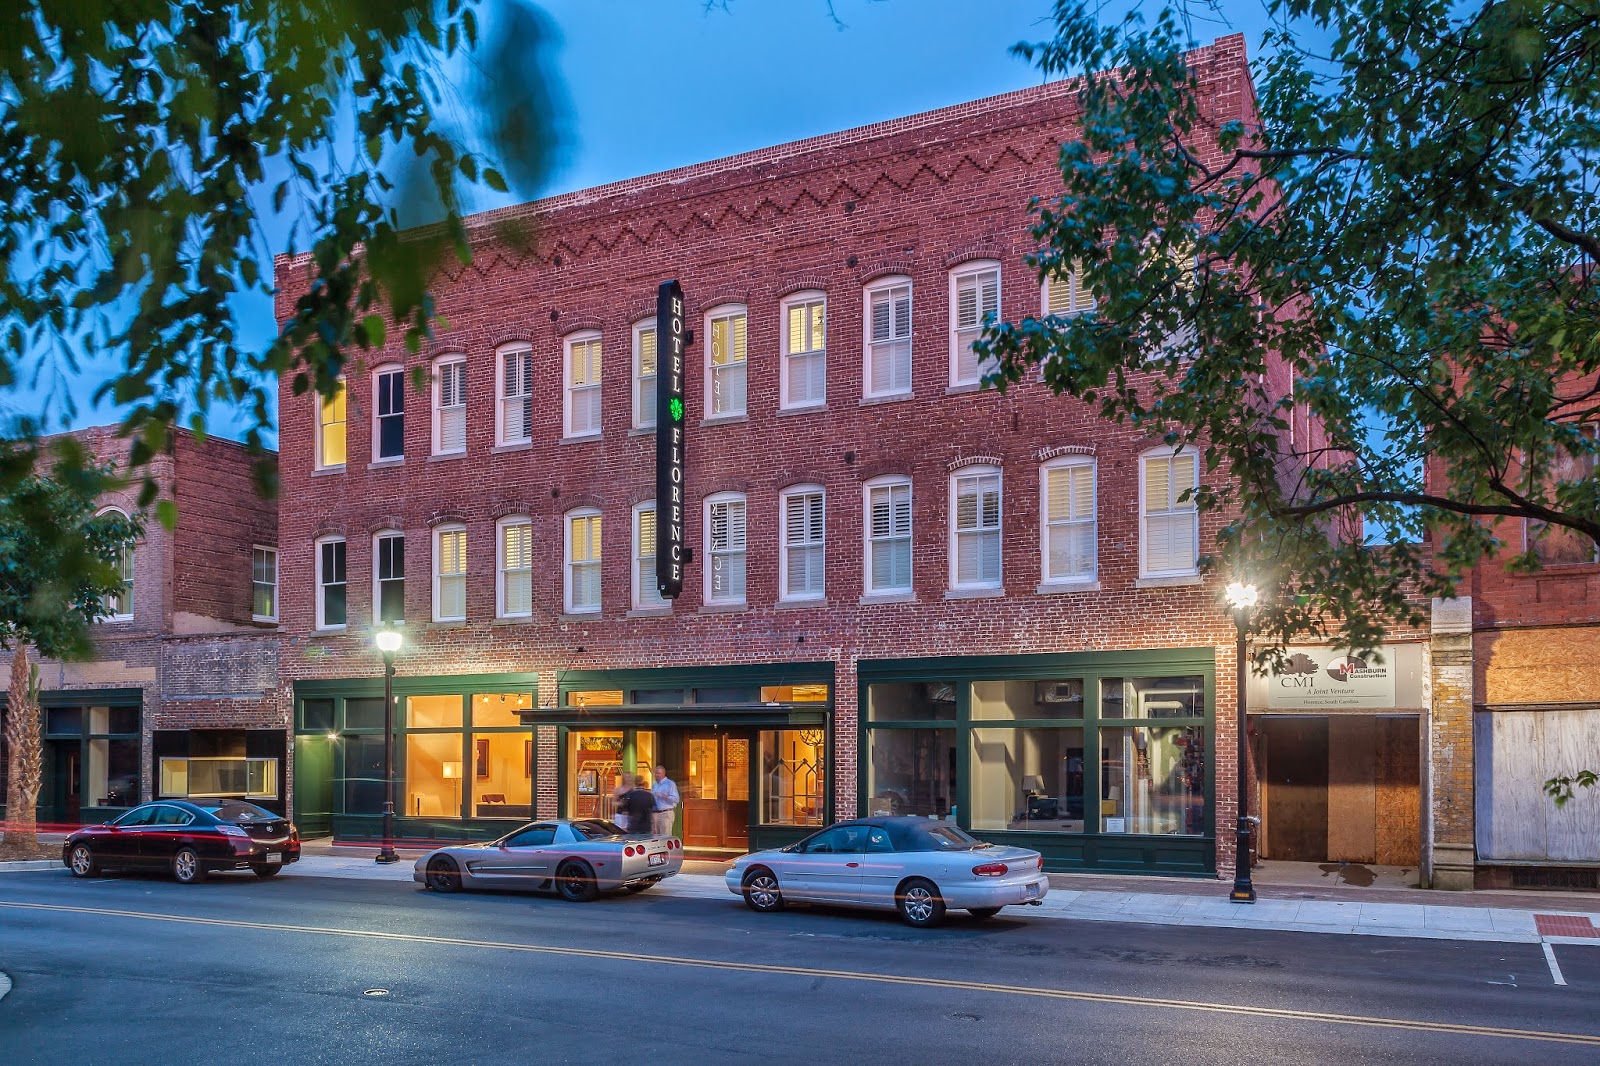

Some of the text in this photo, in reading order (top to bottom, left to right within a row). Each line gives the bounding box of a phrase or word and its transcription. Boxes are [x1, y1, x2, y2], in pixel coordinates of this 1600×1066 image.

[671, 297, 682, 581] HOTEL FLORENCE
[1339, 663, 1387, 675] MASHBURN
[1281, 677, 1314, 688] CMI
